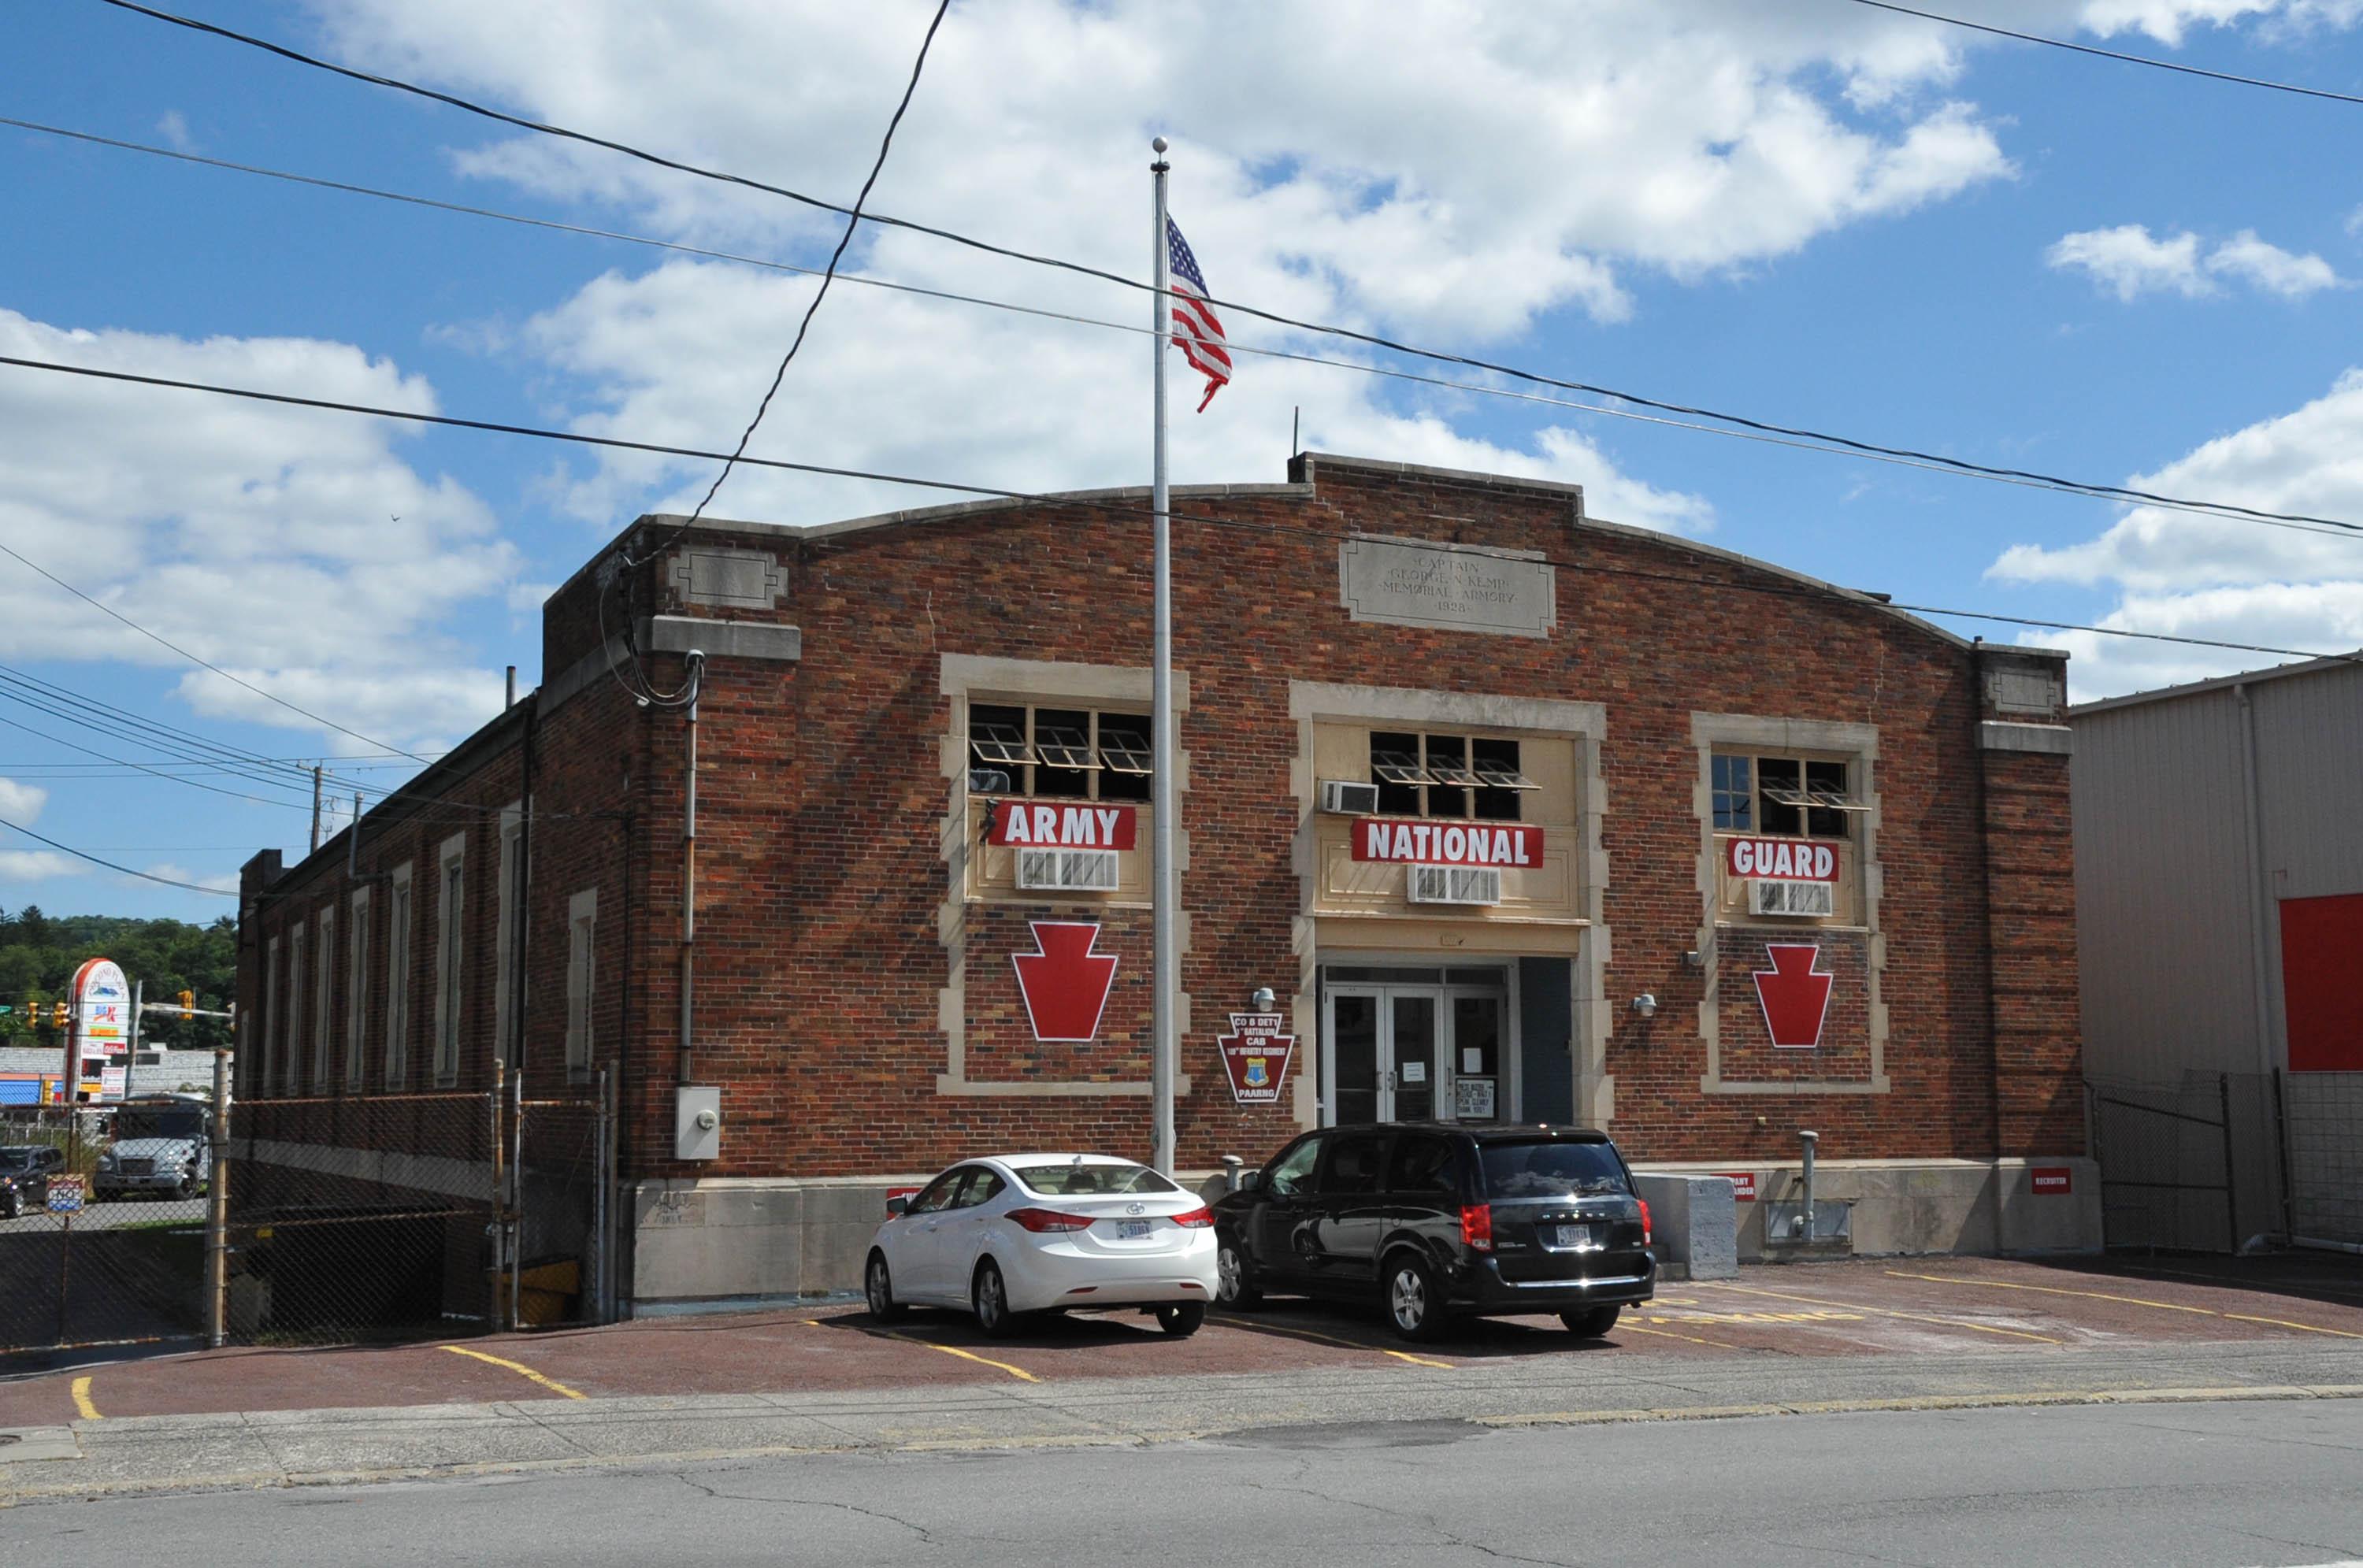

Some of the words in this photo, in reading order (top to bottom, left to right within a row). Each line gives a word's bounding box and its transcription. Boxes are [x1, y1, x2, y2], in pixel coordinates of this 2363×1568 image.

[1418, 557, 1479, 573] CAPTAIN
[1390, 568, 1449, 585] GEORGE
[1468, 576, 1507, 589] KEMP
[1382, 581, 1452, 599] MEMORIAL
[1462, 591, 1516, 604] ARMORY
[1004, 805, 1120, 846] ARMY
[1367, 823, 1530, 865] NATIONAL
[1734, 840, 1834, 878] GUARD
[1234, 1018, 1247, 1026] CO
[1246, 1037, 1266, 1046] CAB
